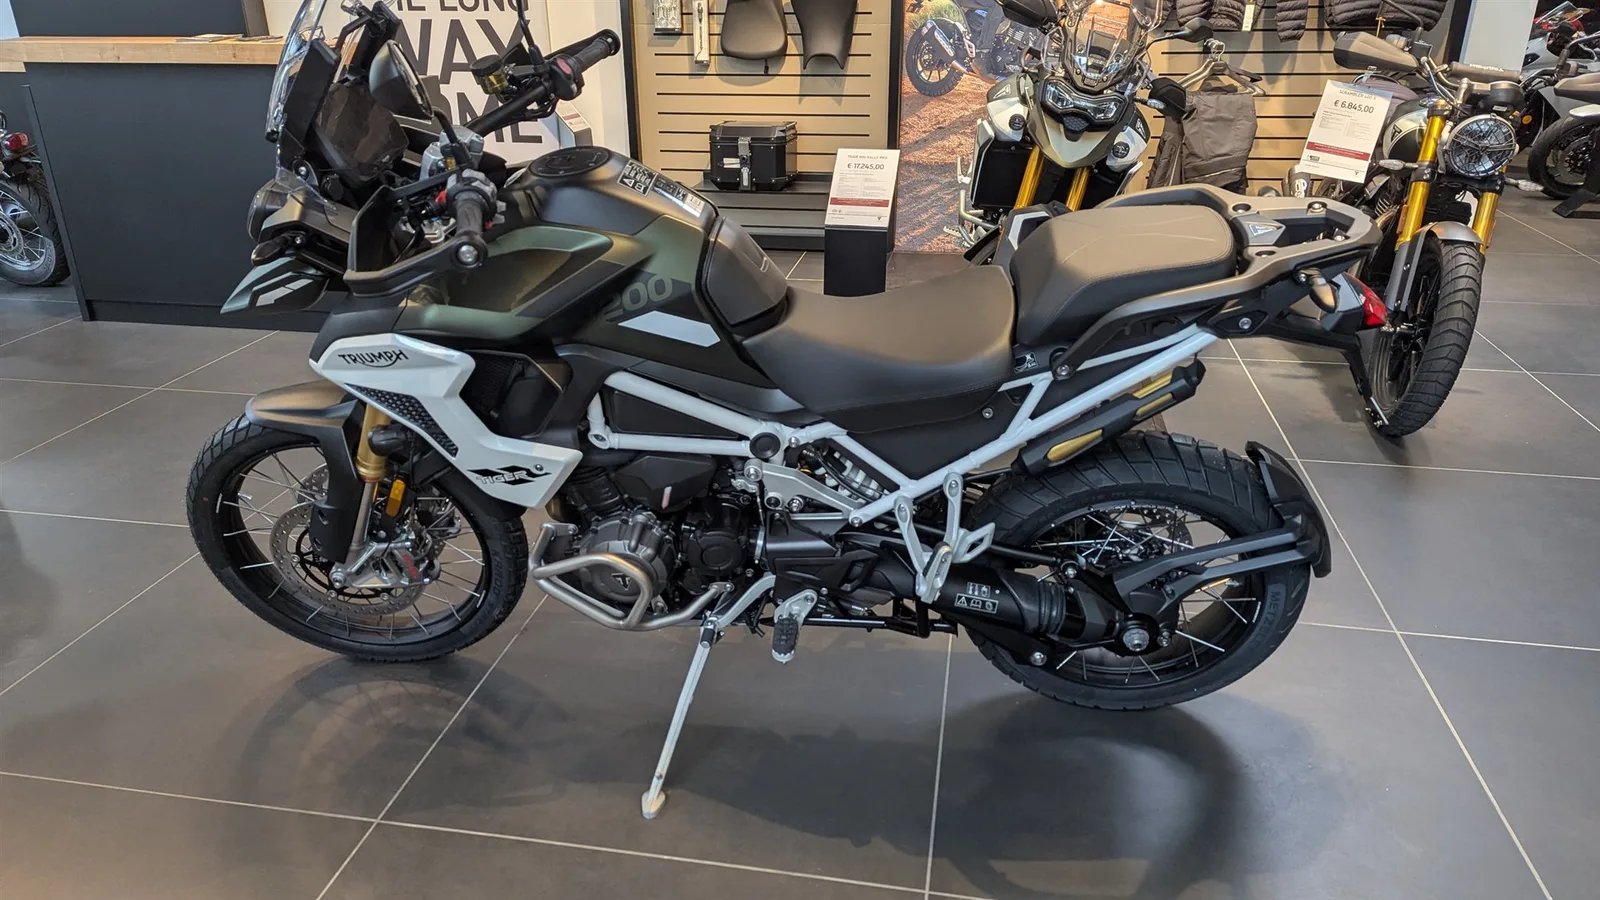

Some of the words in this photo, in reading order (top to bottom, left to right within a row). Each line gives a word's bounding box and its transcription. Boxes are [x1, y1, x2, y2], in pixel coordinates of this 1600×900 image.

[1340, 101, 1374, 114] 6.845,00
[338, 349, 409, 368] TRIUMPH
[480, 470, 530, 485] TIGER
